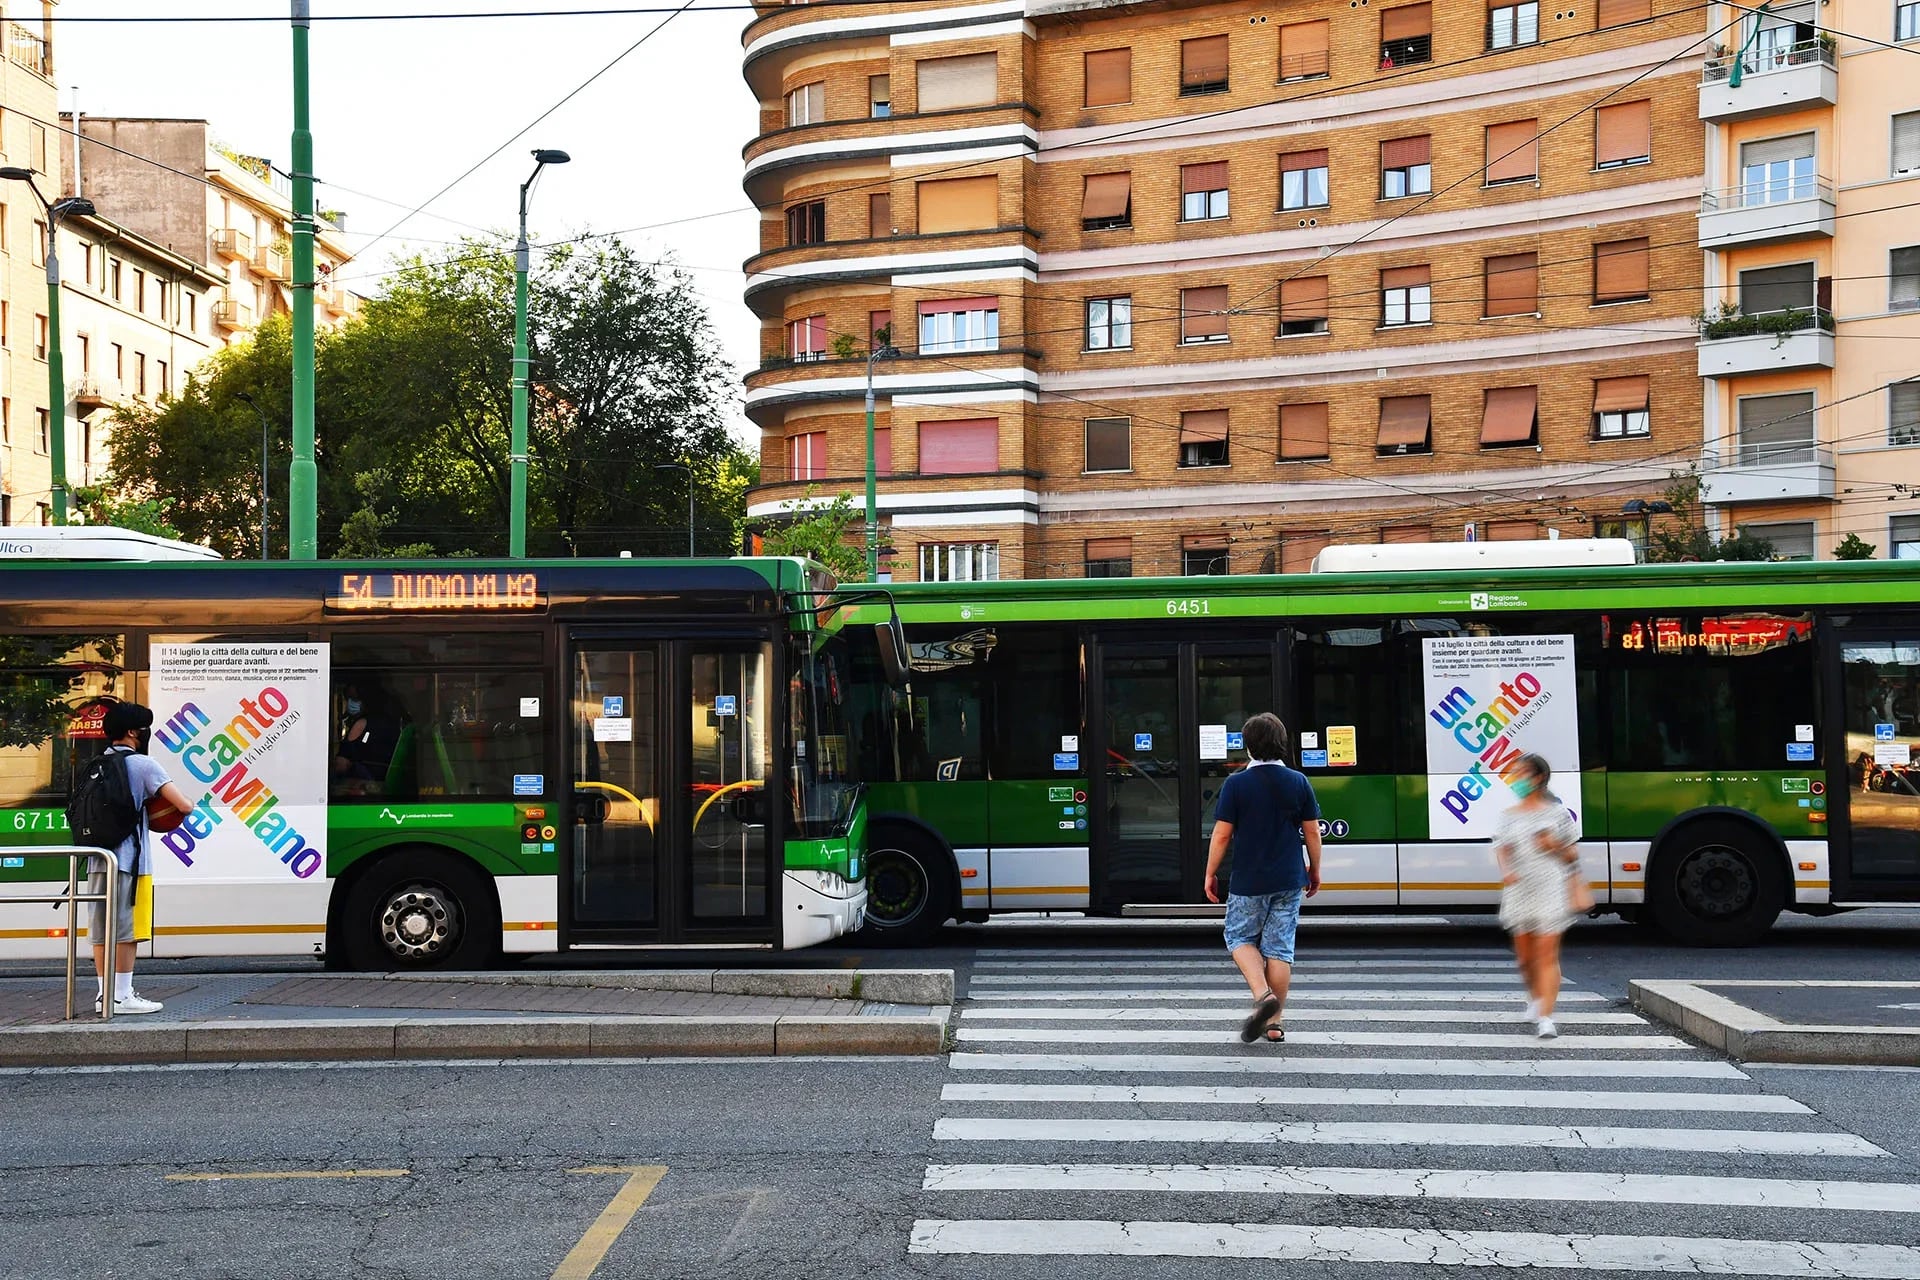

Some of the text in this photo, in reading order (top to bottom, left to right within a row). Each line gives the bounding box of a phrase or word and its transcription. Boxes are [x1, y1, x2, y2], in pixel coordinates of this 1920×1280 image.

[343, 573, 537, 608] 54 DUOMO M1 M3
[1166, 600, 1211, 615] 6451
[180, 648, 201, 658] luglio
[1446, 641, 1465, 650] luglio
[1470, 648, 1500, 656] guardare
[1622, 632, 1768, 649] 81 LAMBRATE FS
[194, 658, 206, 666] per
[208, 658, 242, 666] guardare
[154, 702, 211, 754] un
[1430, 686, 1476, 730] un
[1454, 671, 1541, 754] Canto
[1514, 709, 1536, 731] luglio
[1532, 691, 1552, 712] 2020
[182, 686, 289, 784] Canto
[245, 710, 301, 765] 14 luglio 2020
[1440, 761, 1492, 825] per
[13, 812, 70, 829] 6711
[160, 792, 223, 868] per
[210, 761, 322, 879] Milano
